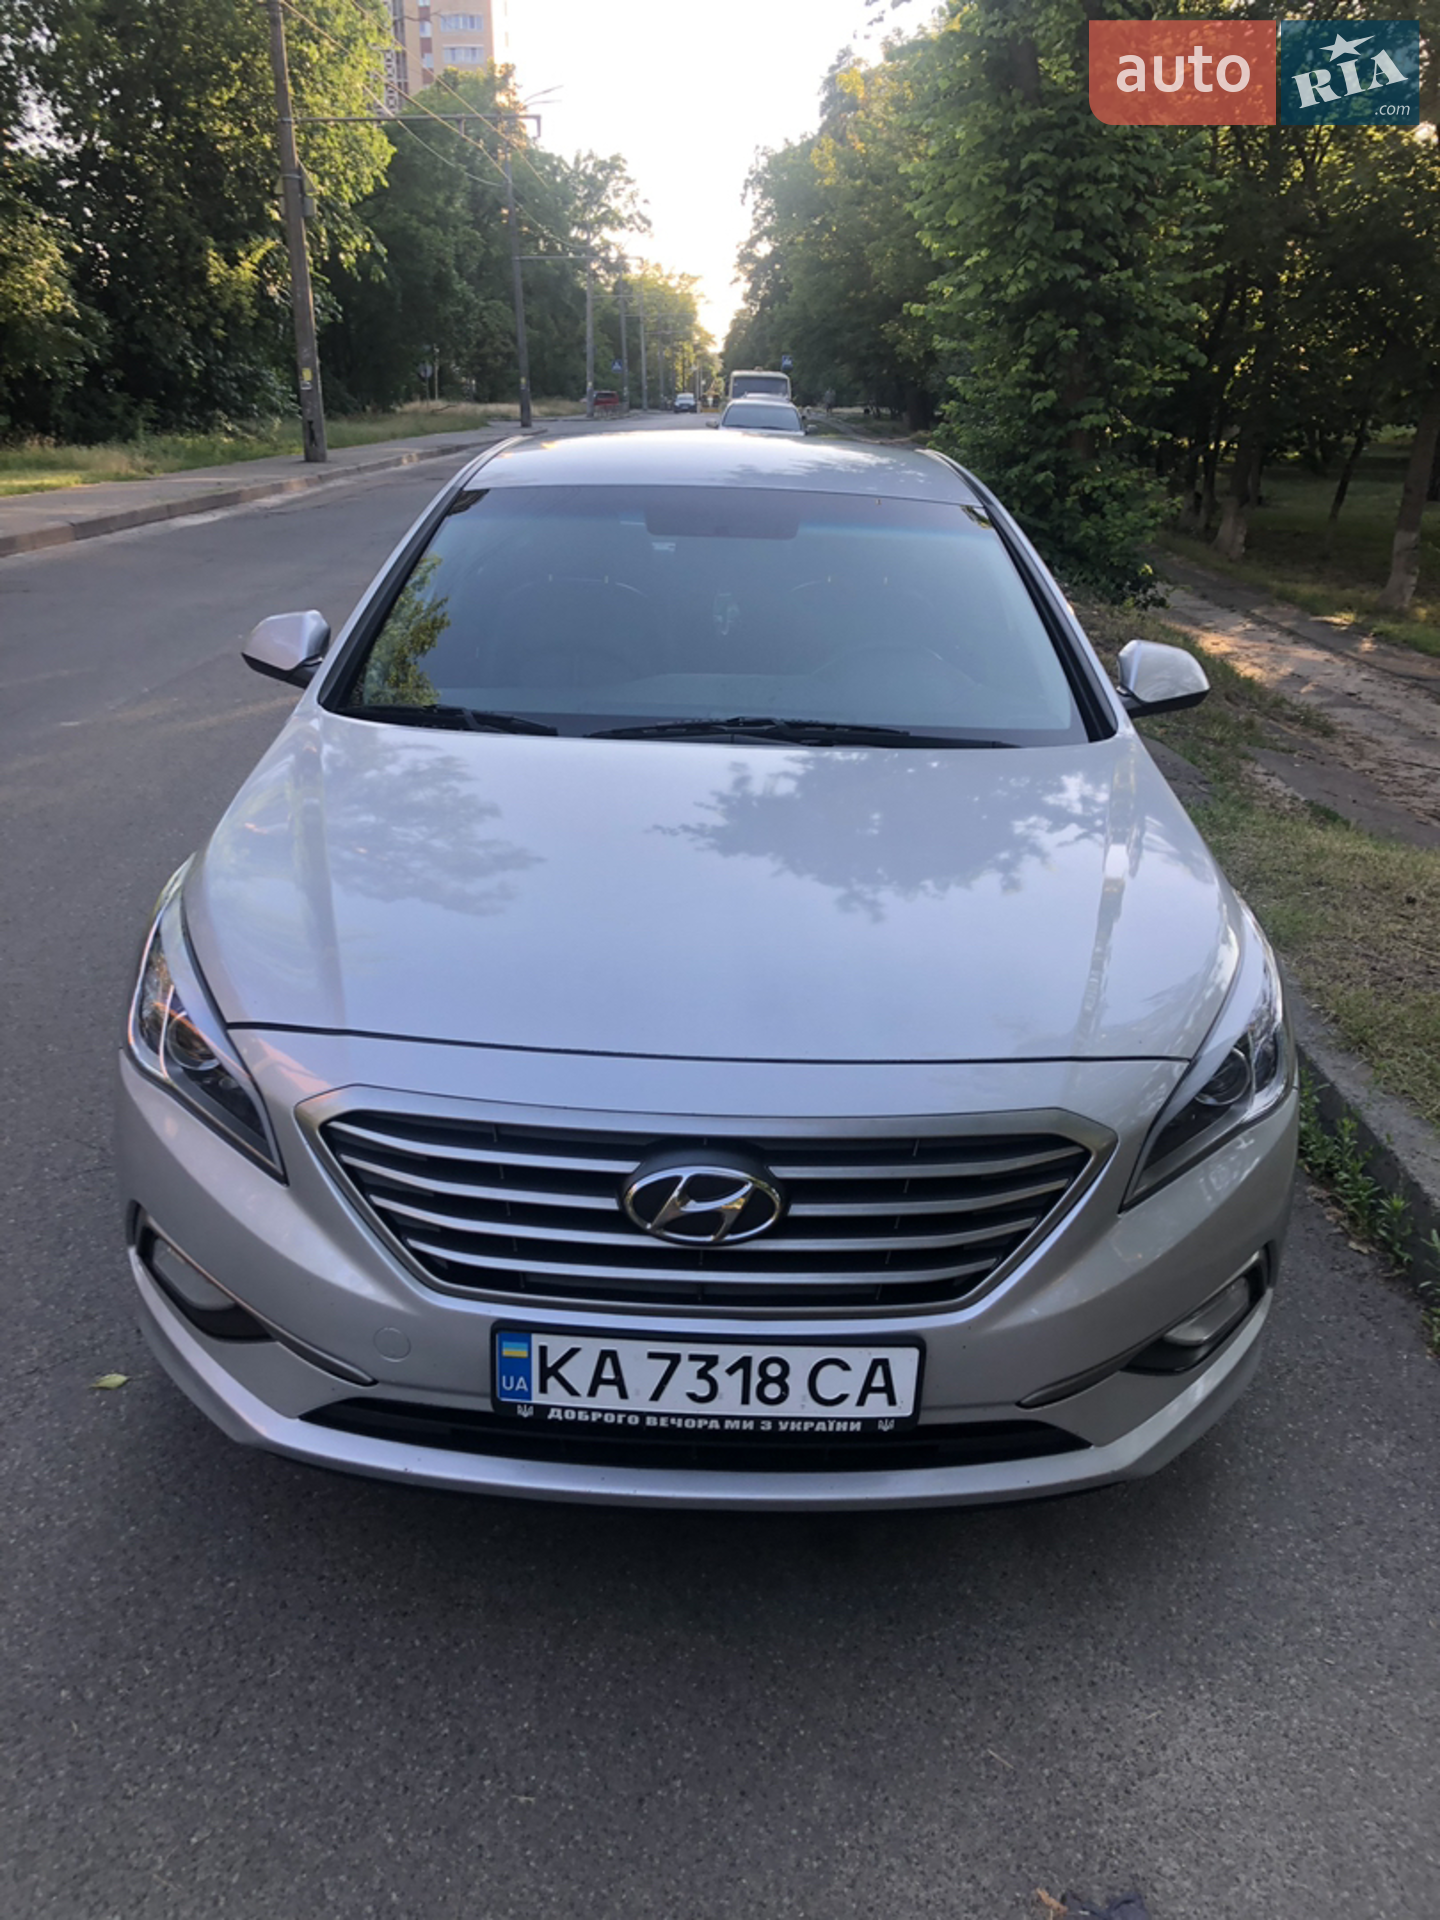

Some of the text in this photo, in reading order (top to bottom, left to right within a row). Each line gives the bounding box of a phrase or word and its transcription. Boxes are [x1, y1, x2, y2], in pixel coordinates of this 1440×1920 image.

[501, 1376, 529, 1392] UA
[538, 1345, 898, 1407] KA 7318 CA
[547, 1407, 640, 1425] ДОБРОГО
[645, 1416, 721, 1430] ВЕЧОРА
[723, 1418, 754, 1431] МИ
[778, 1418, 862, 1432] УКРАЇНИ
